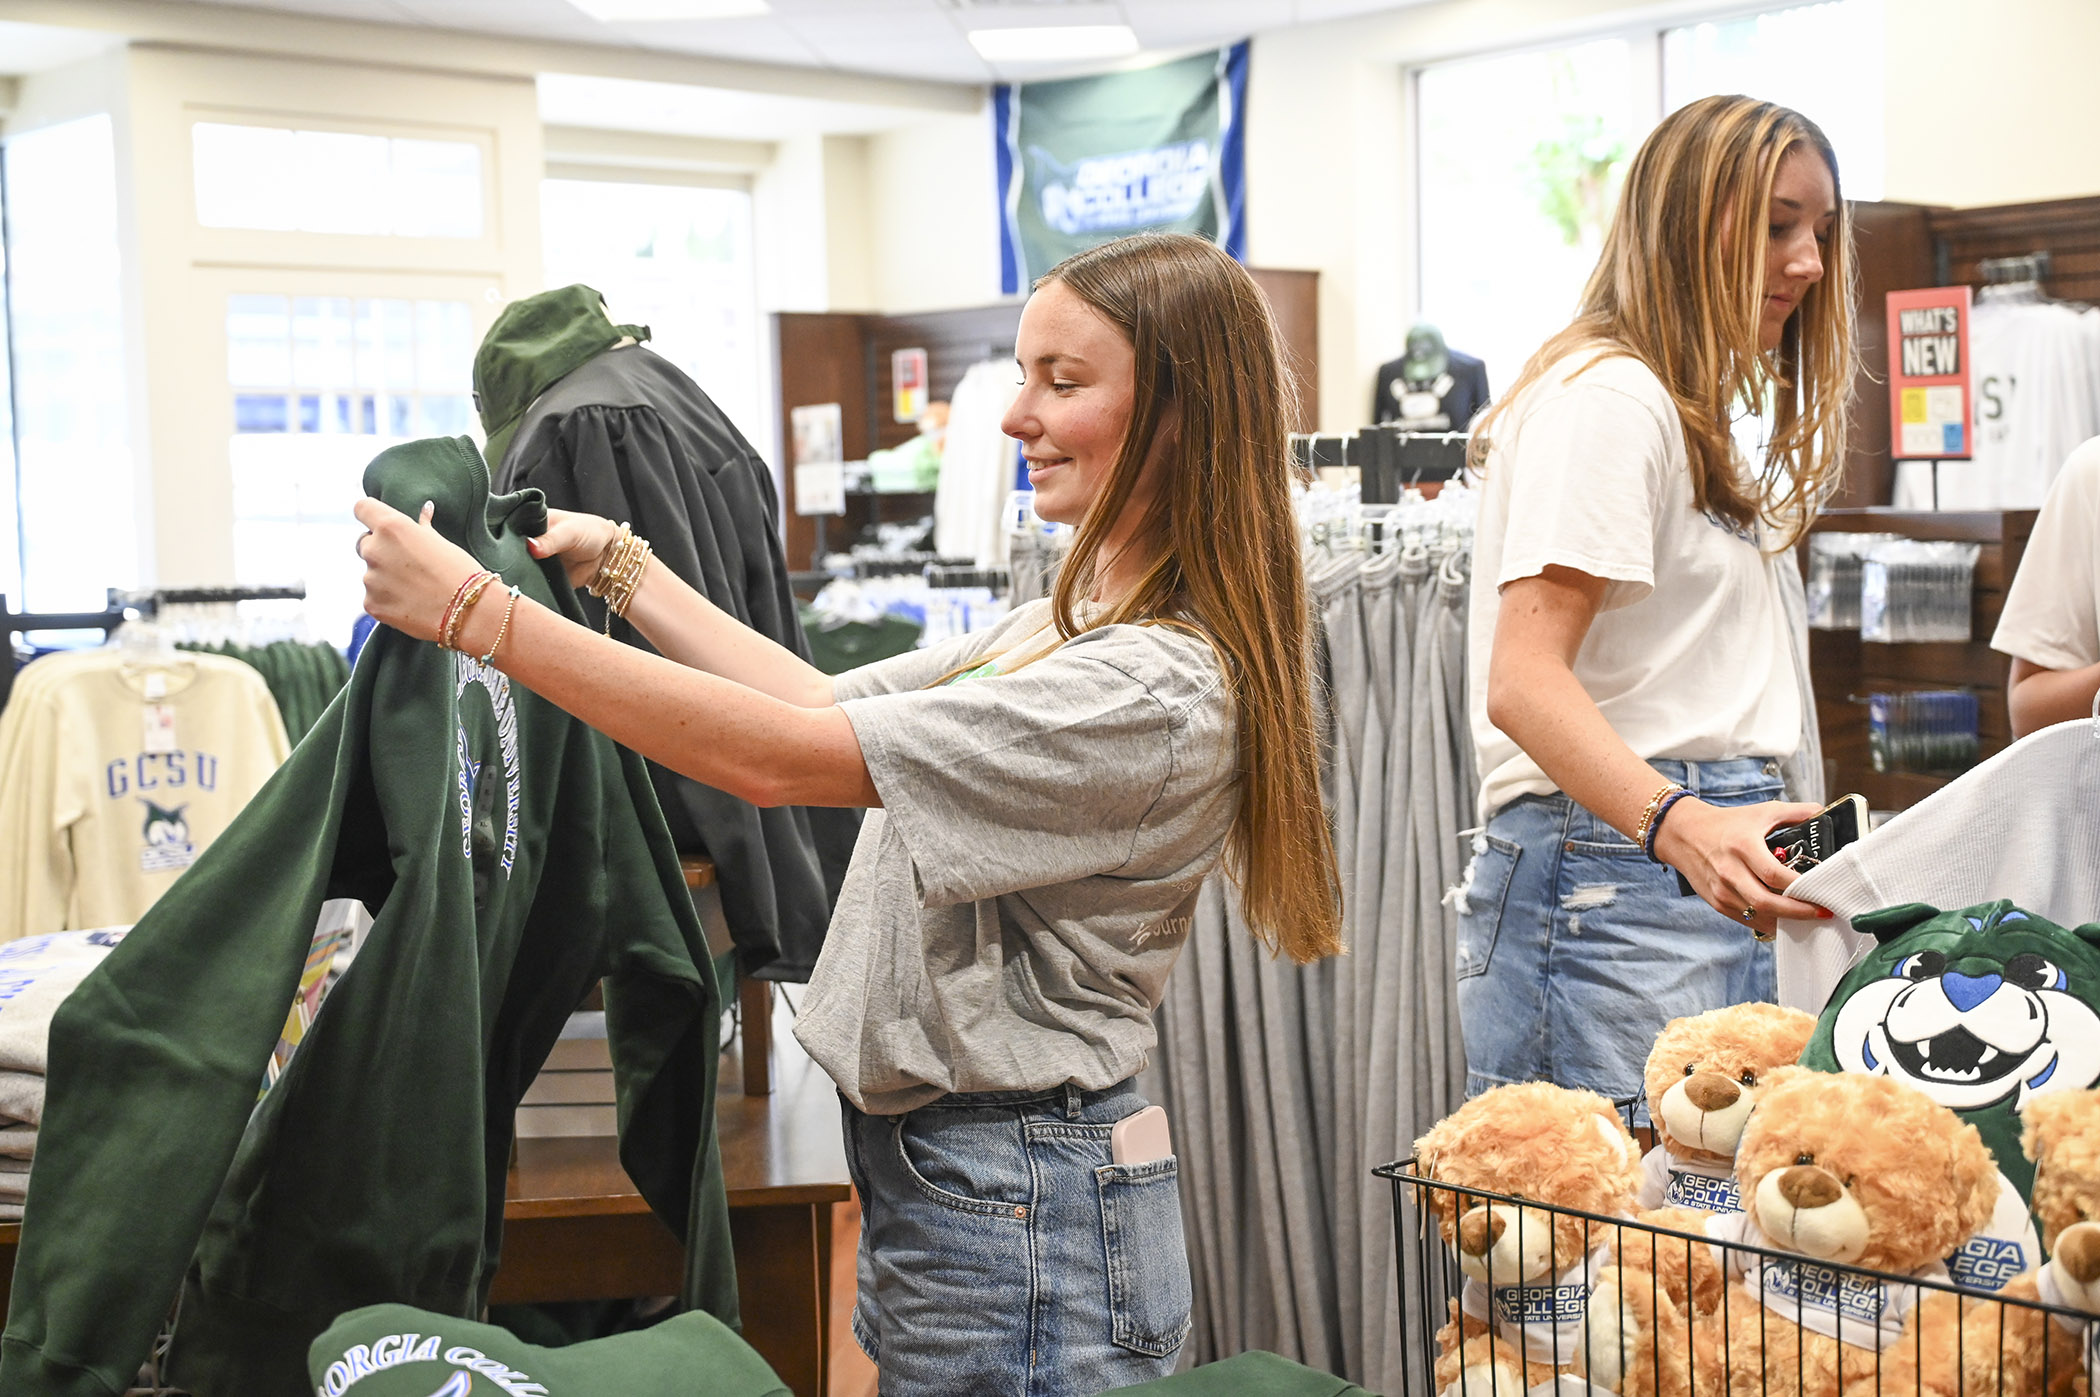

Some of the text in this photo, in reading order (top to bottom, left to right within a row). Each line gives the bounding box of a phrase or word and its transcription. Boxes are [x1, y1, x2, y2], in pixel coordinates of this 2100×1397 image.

[1900, 306, 1957, 334] WHAT'S
[1902, 336, 1957, 376] NEW
[107, 750, 217, 798] GCSU
[1691, 1201, 1710, 1209] STATE
[1958, 1239, 2020, 1264] GIA
[1801, 1293, 1822, 1304] TATE
[1822, 1297, 1877, 1319] UNVERSITY
[319, 1333, 442, 1397] ORGIA
